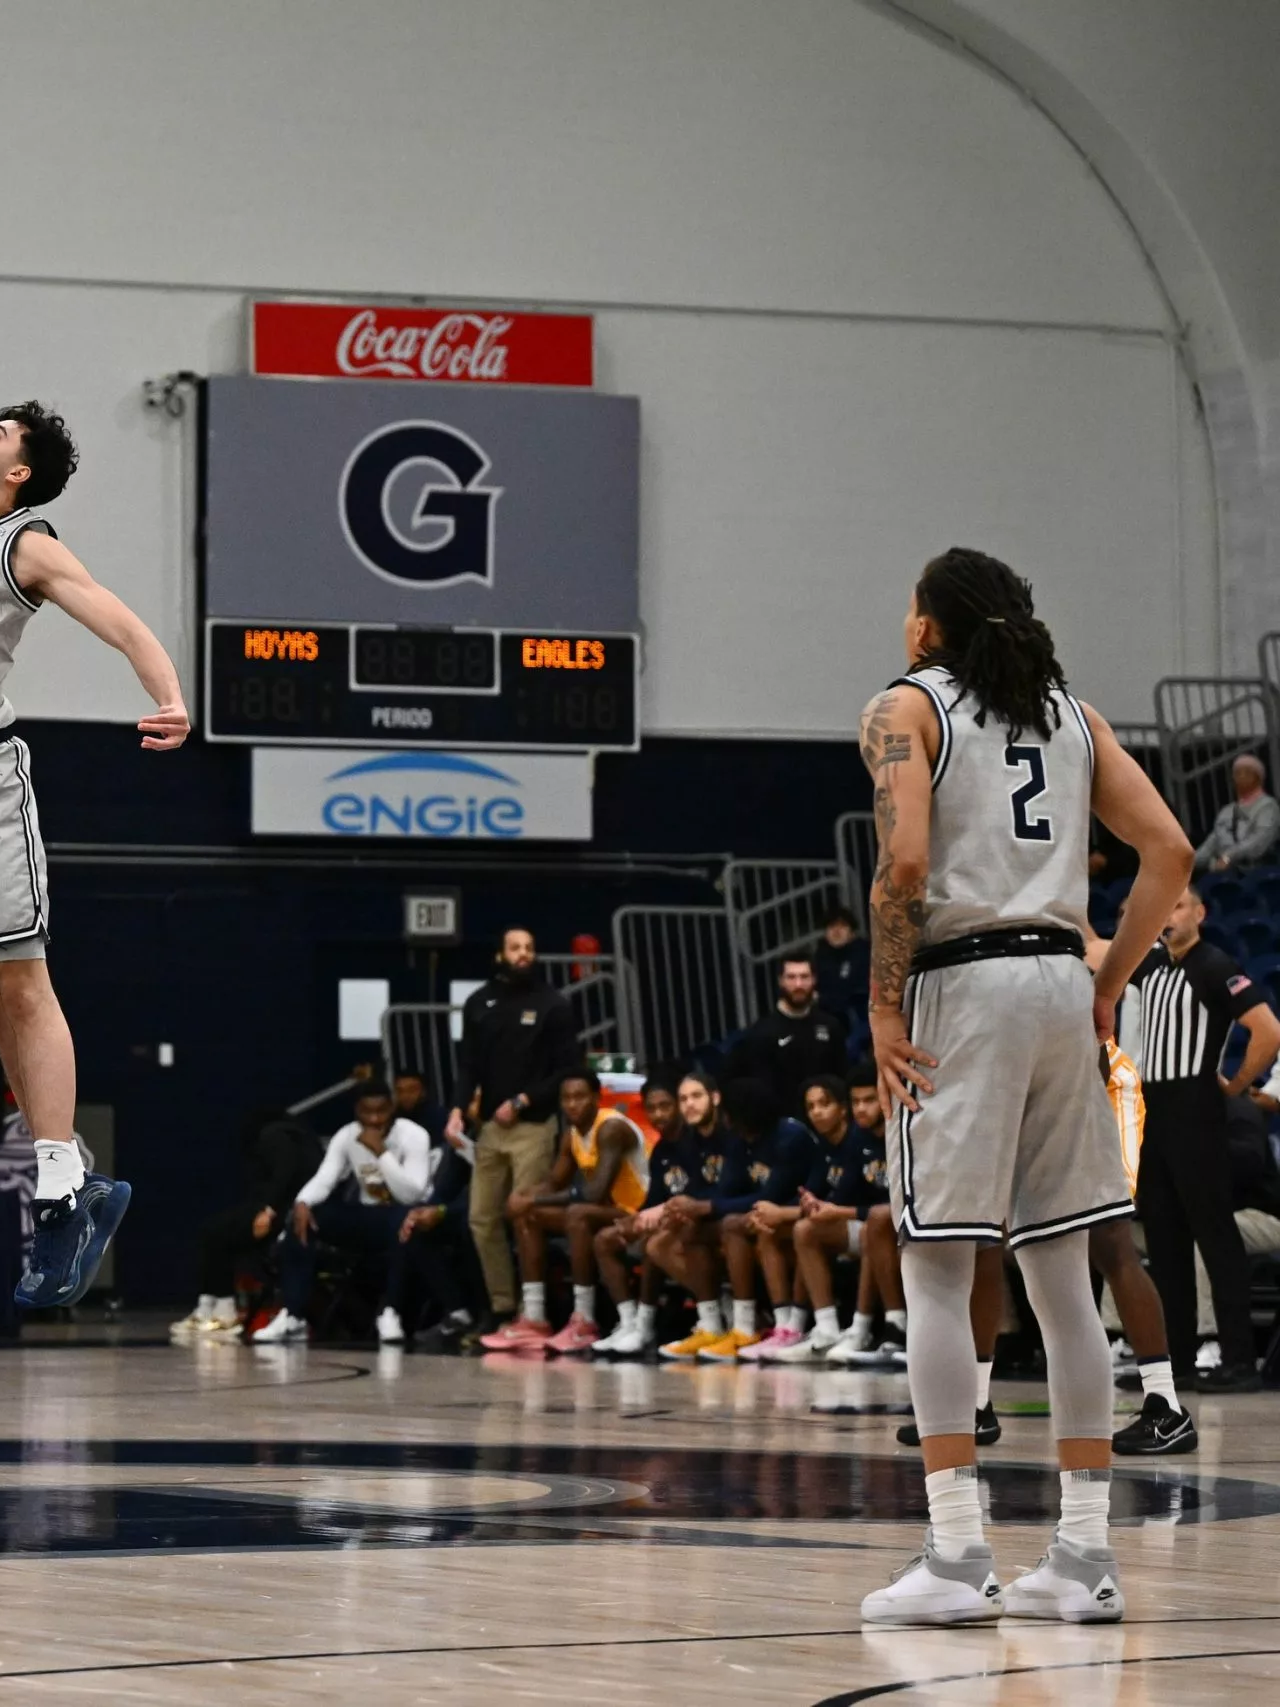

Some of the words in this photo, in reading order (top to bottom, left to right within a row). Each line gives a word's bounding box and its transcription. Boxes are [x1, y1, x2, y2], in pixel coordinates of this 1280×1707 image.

[336, 310, 514, 379] Coca-Cola
[244, 629, 319, 661] HOYAS
[522, 638, 606, 670] EAGLES
[1002, 743, 1055, 843] 2
